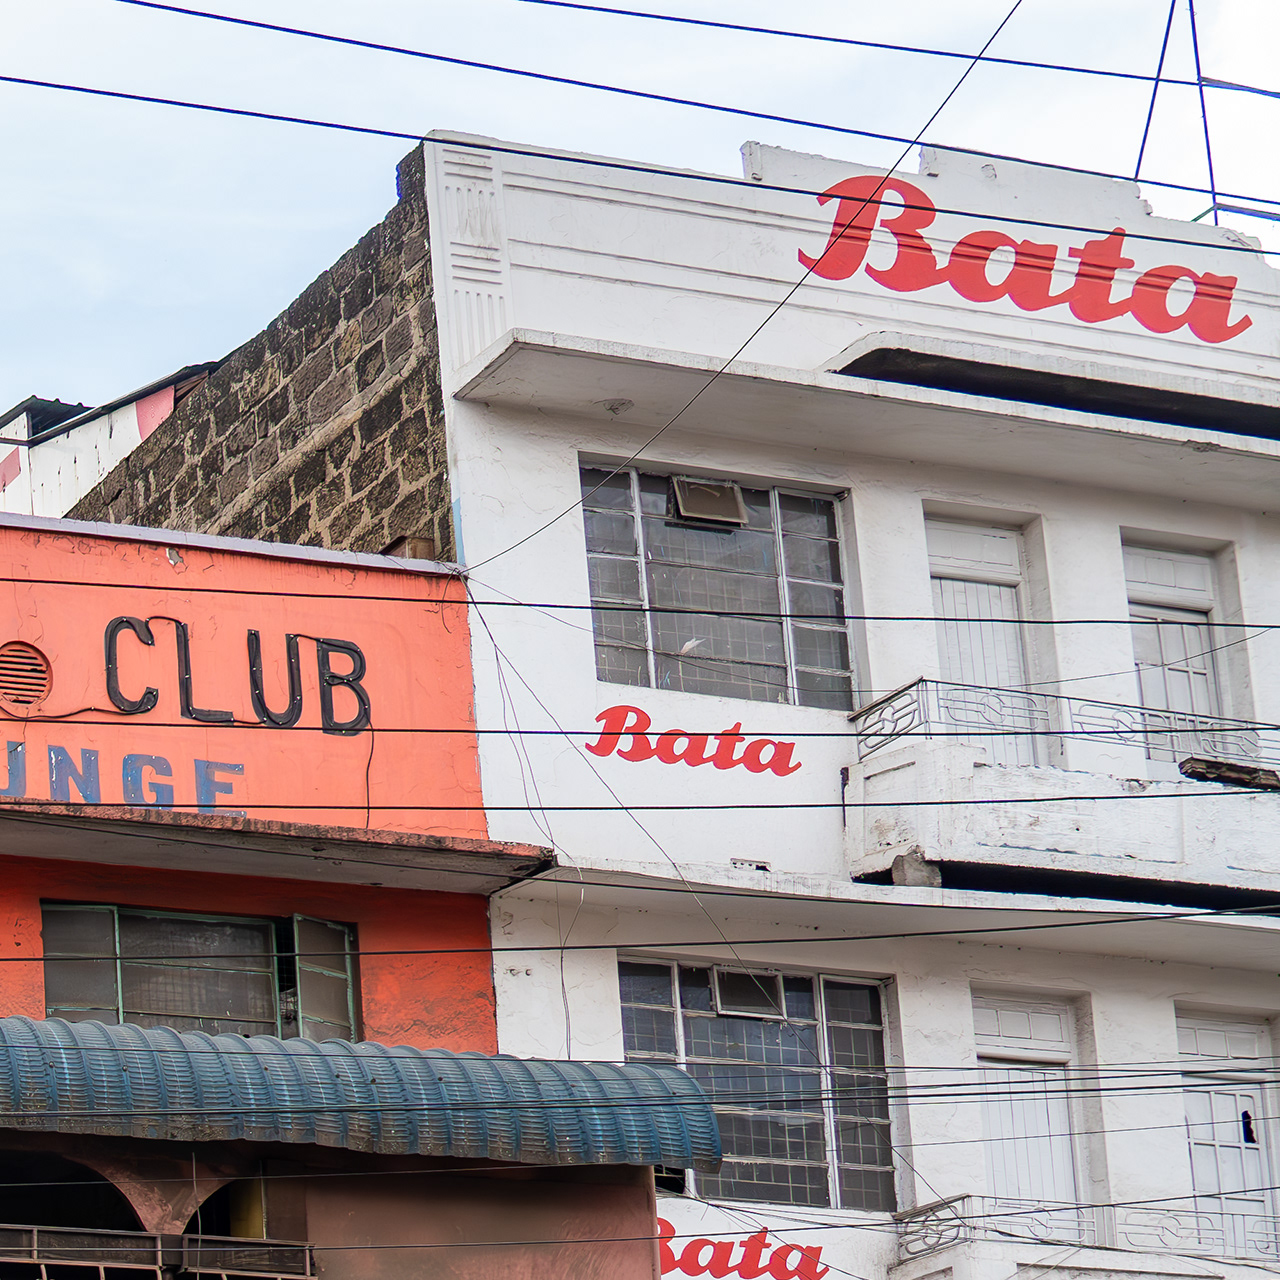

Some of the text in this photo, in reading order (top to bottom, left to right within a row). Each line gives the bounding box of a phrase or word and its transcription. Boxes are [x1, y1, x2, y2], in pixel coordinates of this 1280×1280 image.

[797, 174, 1253, 344] Bata
[103, 614, 372, 736] CLUB
[584, 703, 802, 777] Bata
